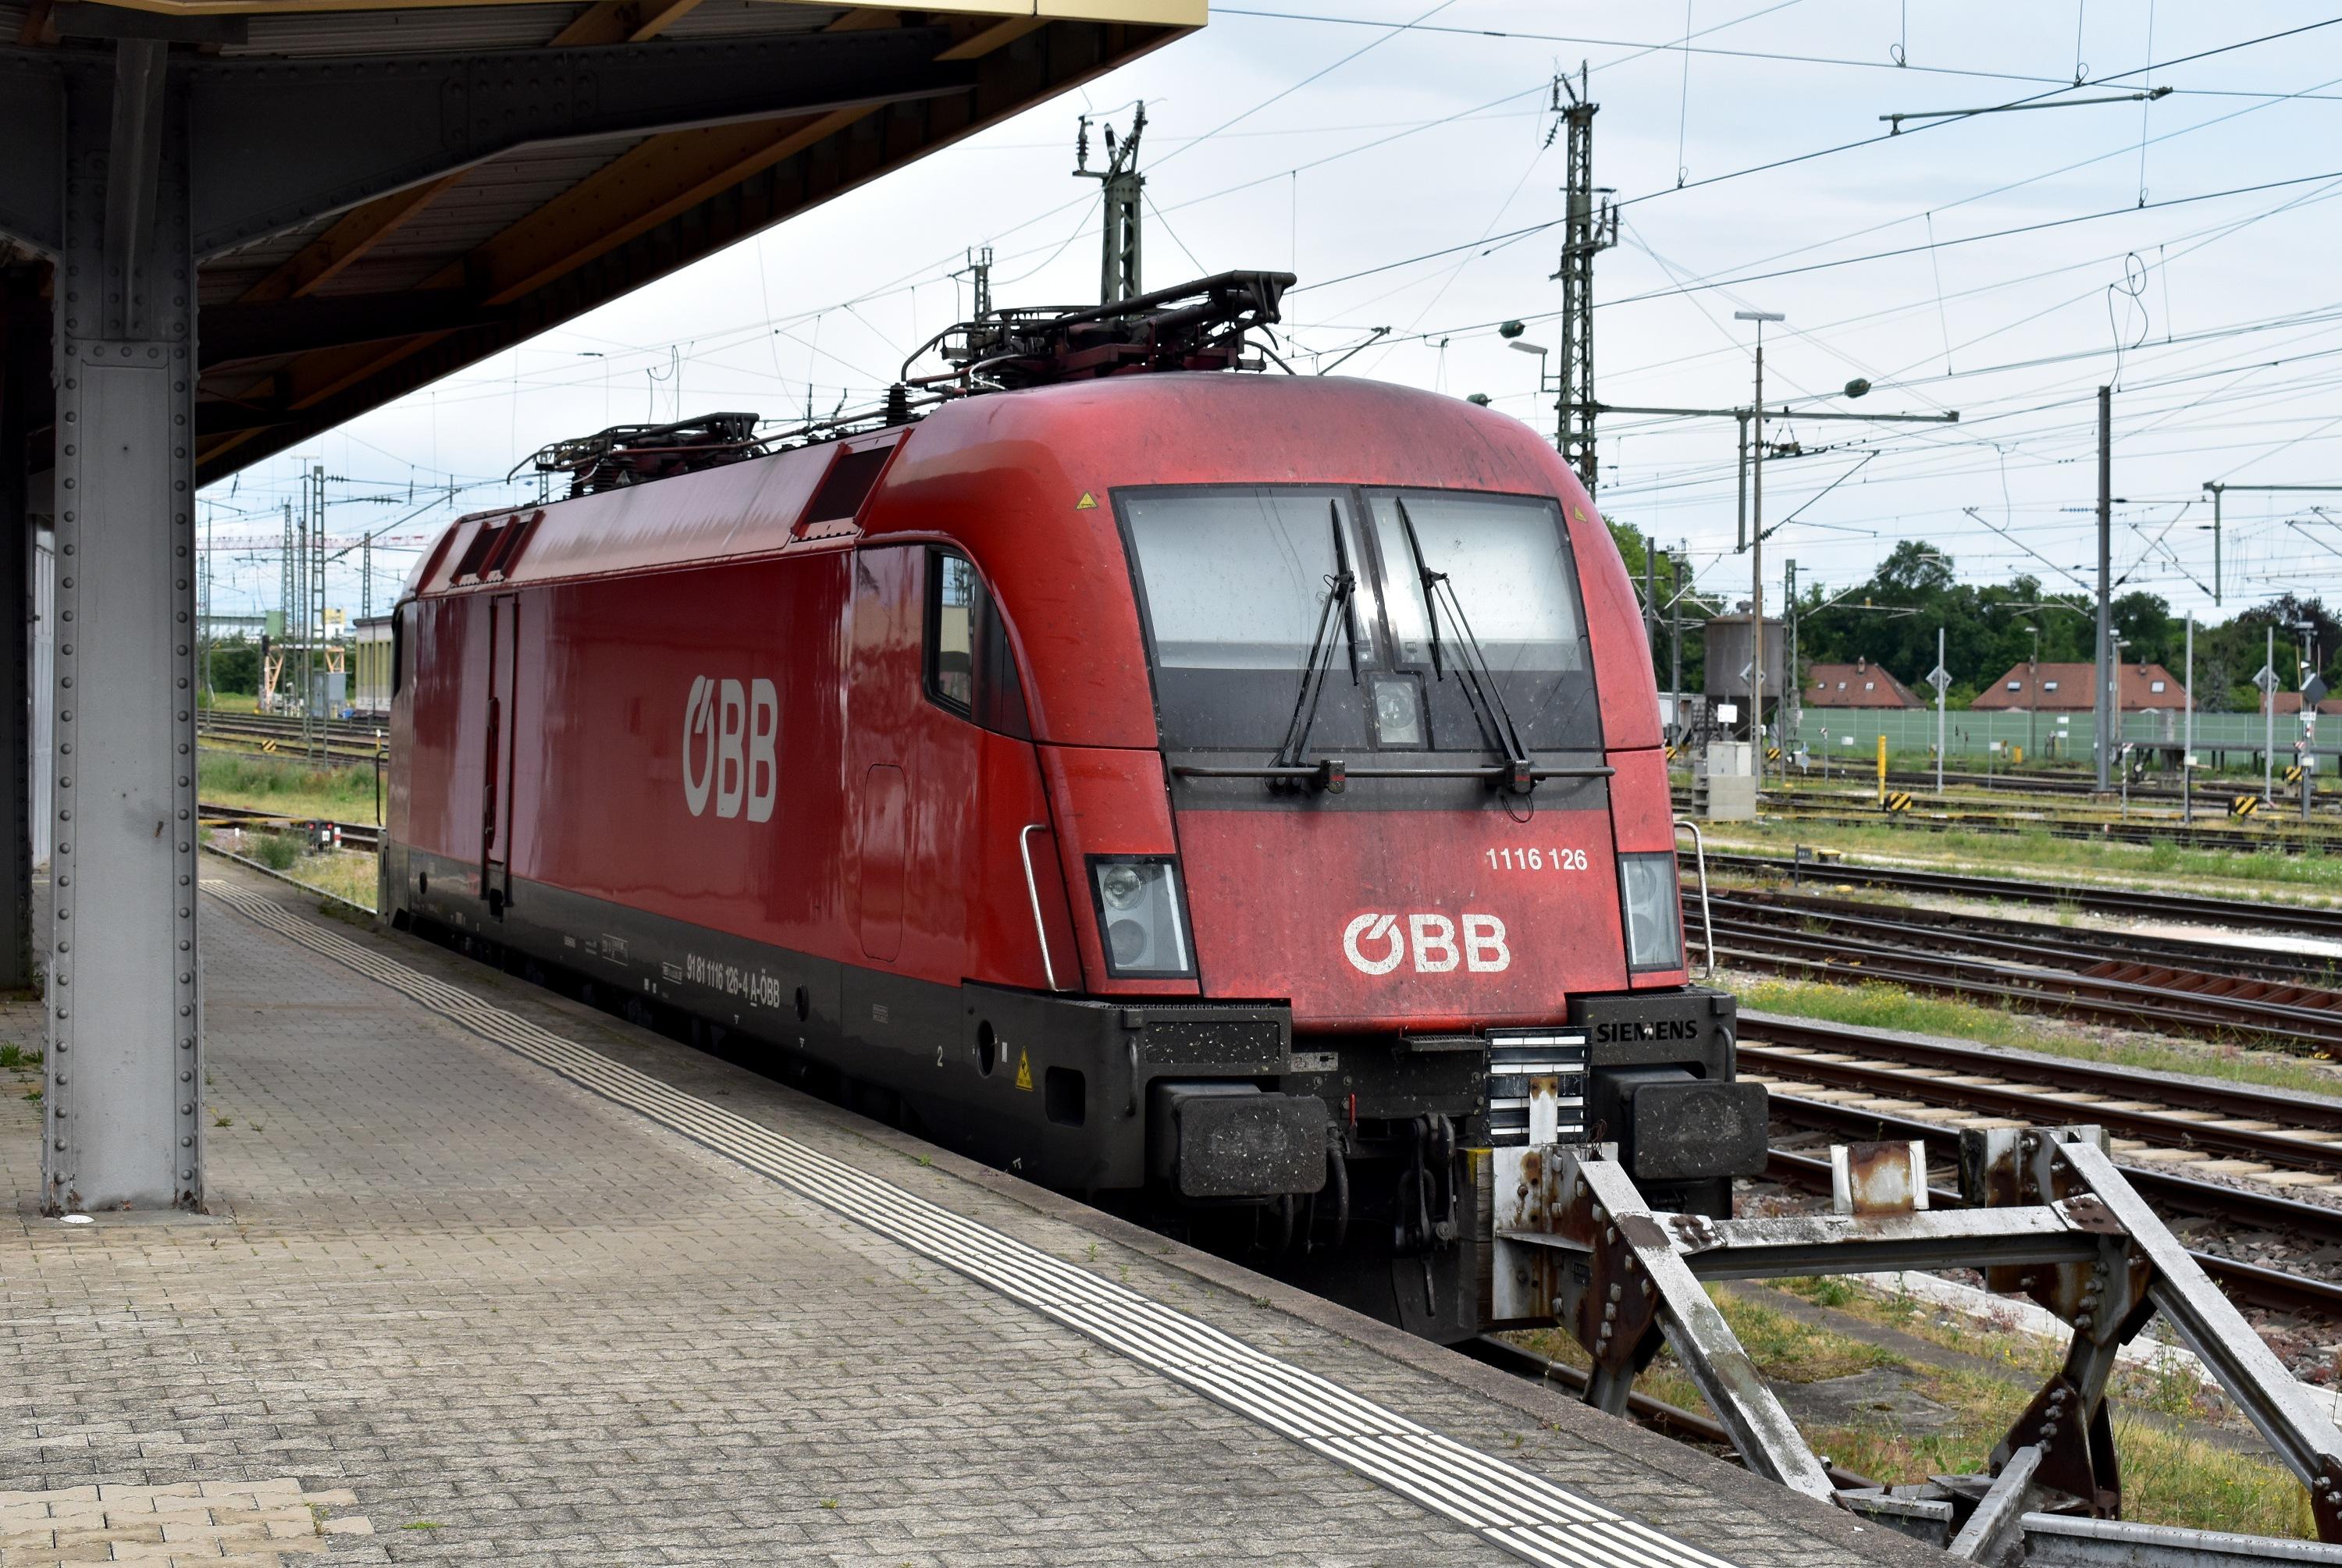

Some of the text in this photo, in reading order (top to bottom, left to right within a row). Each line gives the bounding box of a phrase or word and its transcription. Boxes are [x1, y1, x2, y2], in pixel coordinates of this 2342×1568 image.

[682, 674, 778, 823] ÖBB
[1486, 848, 1588, 871] 1116 126
[1343, 912, 1511, 976] ÖBB
[707, 960, 724, 991] 1116
[1596, 1019, 1698, 1044] SIEMENS
[936, 1044, 944, 1068] 2
